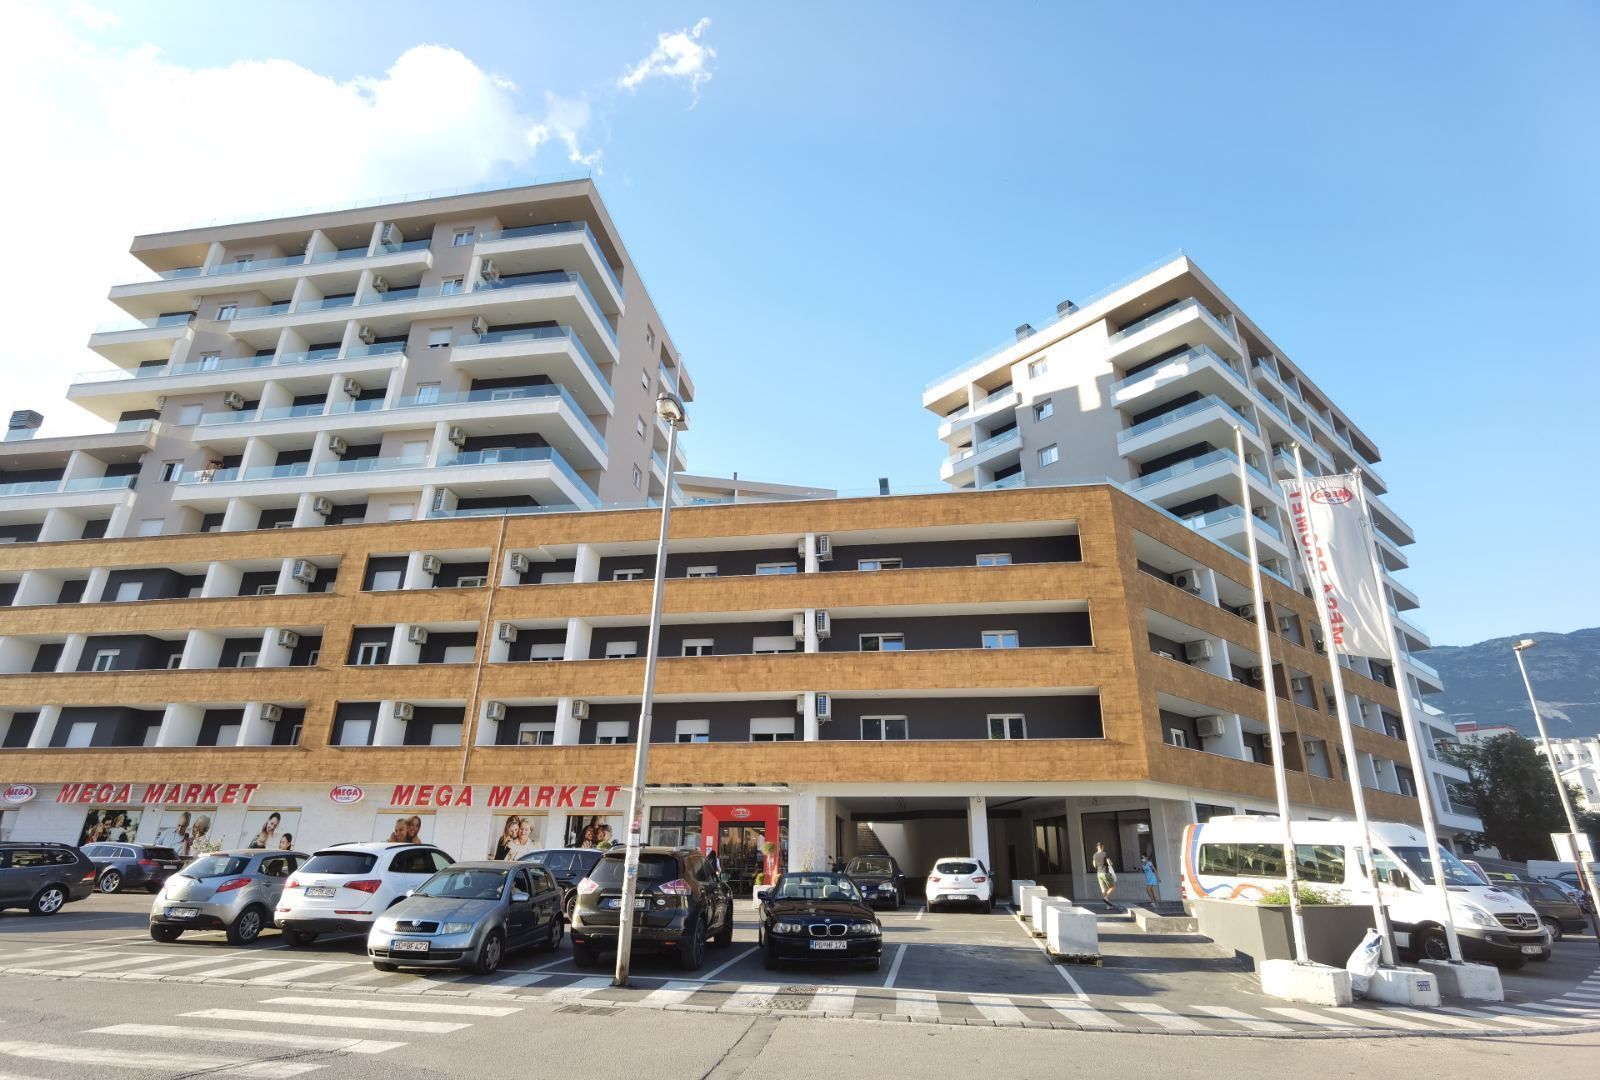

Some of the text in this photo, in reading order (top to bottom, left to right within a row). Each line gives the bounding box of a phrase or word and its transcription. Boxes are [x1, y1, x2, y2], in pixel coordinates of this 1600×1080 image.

[4, 787, 30, 796] MEGA
[56, 783, 260, 804] MEGA MARKET
[332, 787, 359, 797] MEGA
[390, 784, 622, 808] MEGA MARKET
